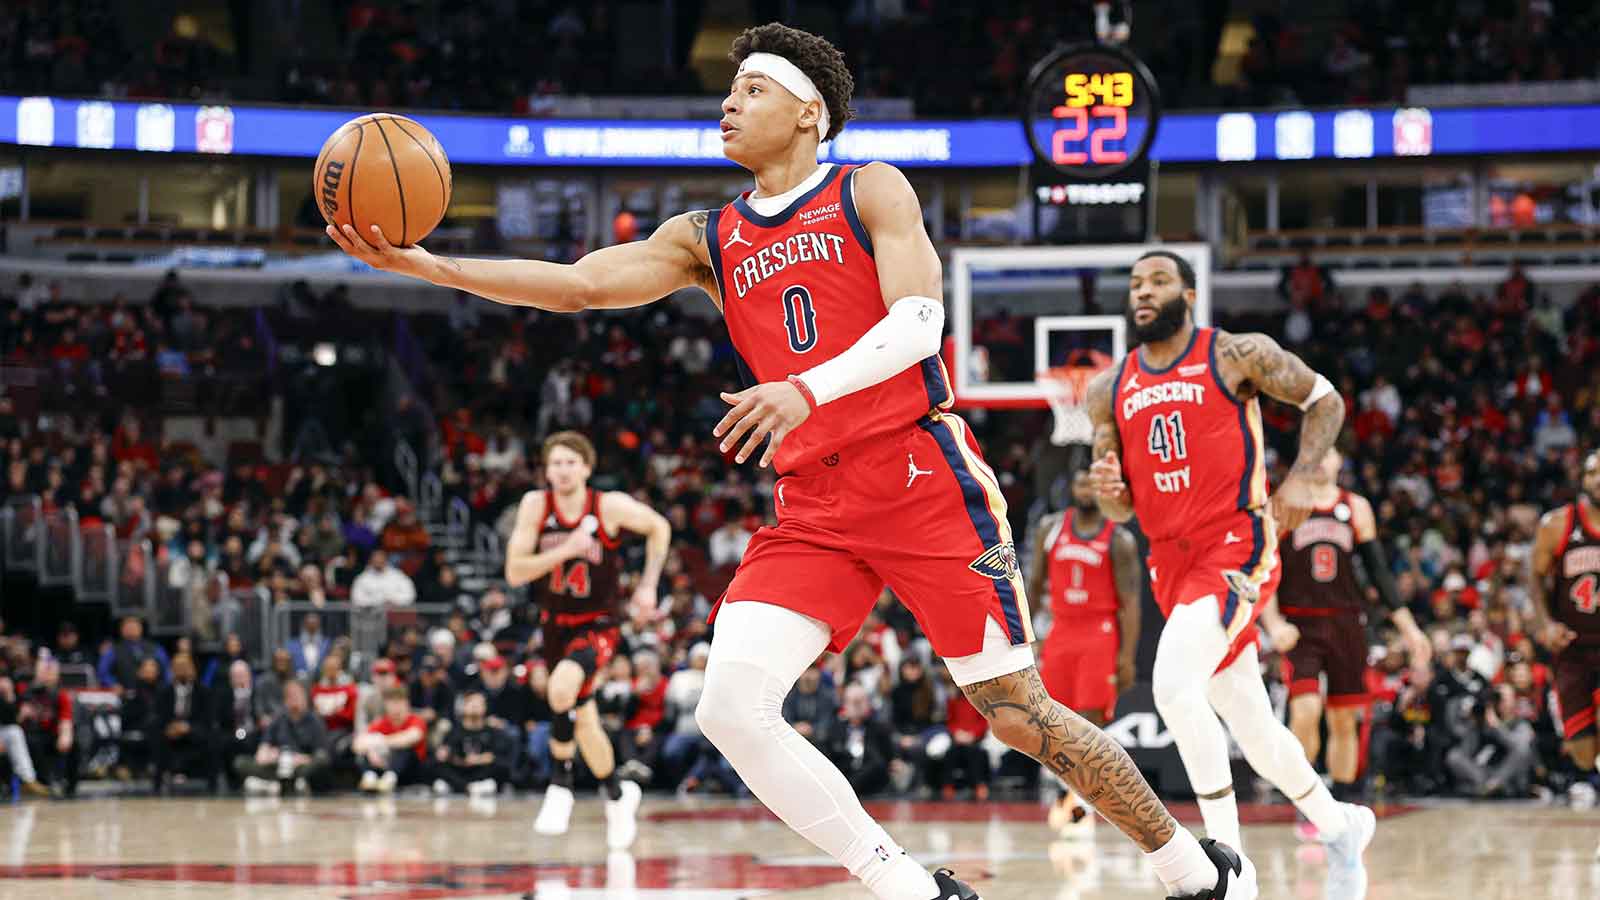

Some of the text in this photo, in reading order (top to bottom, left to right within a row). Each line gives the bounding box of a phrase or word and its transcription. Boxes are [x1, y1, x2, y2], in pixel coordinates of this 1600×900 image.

[1064, 72, 1134, 108] 5:43
[1051, 106, 1128, 164] 22
[799, 202, 842, 221] NEWAGE
[802, 213, 837, 226] PRODUCTS
[733, 232, 845, 299] CRESCENT
[782, 284, 818, 354] 0
[1123, 381, 1205, 420] CRESCENT
[1148, 410, 1187, 463] 41
[1153, 465, 1191, 493] CITY
[1311, 543, 1338, 583] 9
[1569, 573, 1600, 614] 4
